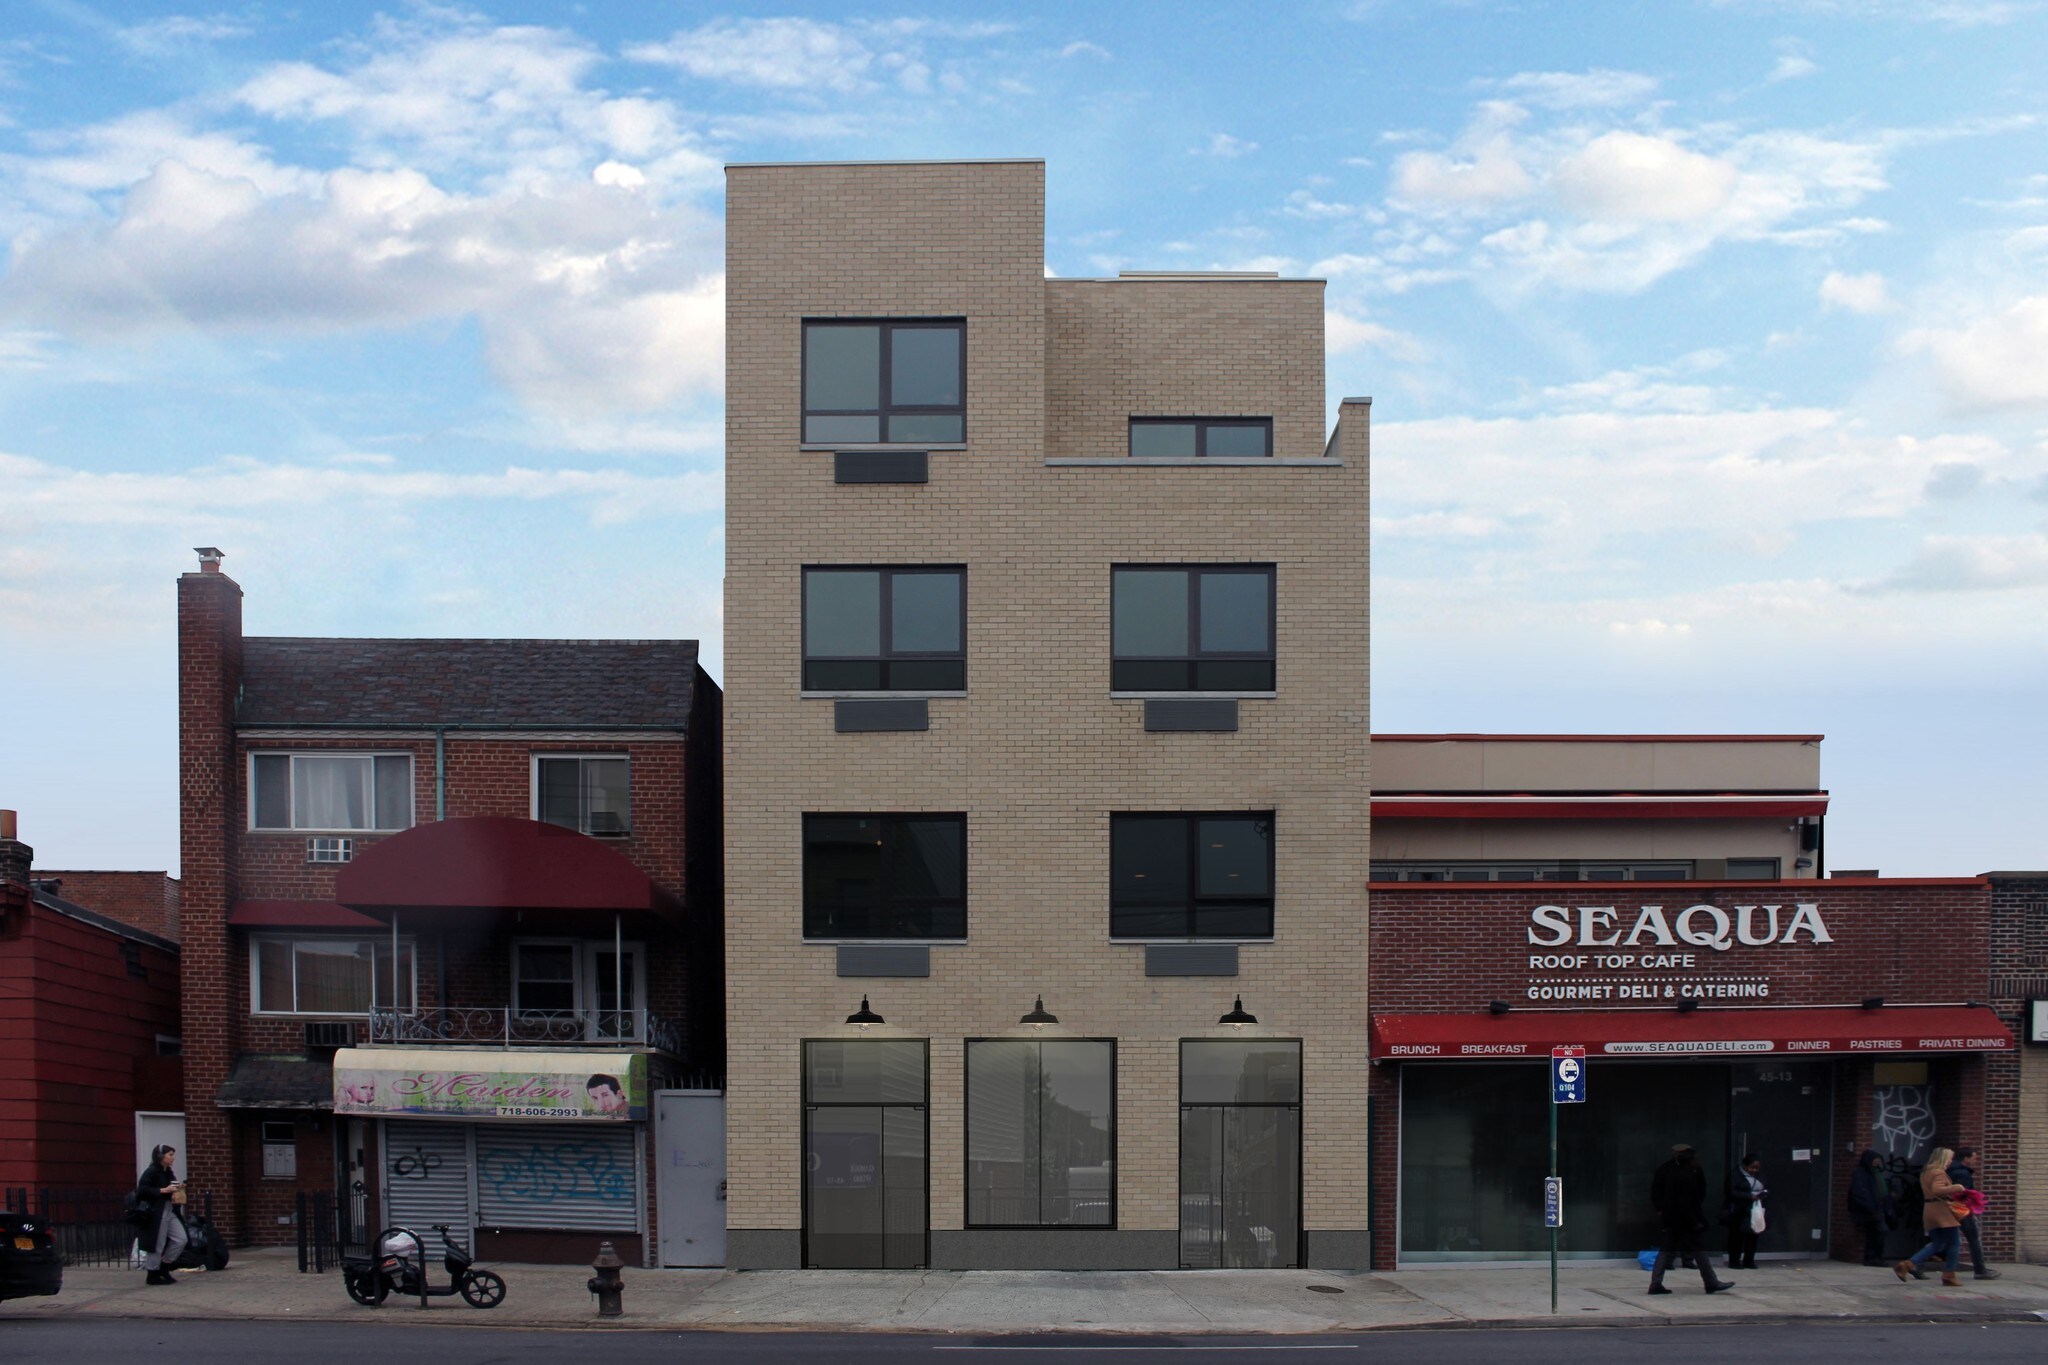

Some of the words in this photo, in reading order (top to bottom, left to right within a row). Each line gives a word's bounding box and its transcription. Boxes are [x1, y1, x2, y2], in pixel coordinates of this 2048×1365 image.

[1528, 903, 1834, 951] SEAQUA
[1529, 955, 1588, 969] ROOF
[1594, 955, 1635, 969] TOP
[1640, 954, 1696, 968] CAFE
[1527, 985, 1614, 1000] GOURMET
[1619, 985, 1658, 999] DELI
[1663, 985, 1675, 998] &
[1681, 984, 1769, 998] CATERING
[1612, 1042, 1767, 1053] www.SEAQUADELI.com
[1787, 1040, 1830, 1050] DINNER
[1850, 1040, 1903, 1049] PASTRIES
[1919, 1039, 1964, 1048] PRIVATE
[1966, 1038, 2006, 1047] DINING
[1391, 1045, 1441, 1055] BRUNCH
[1461, 1044, 1527, 1054] BREAKFAST
[1759, 1072, 1792, 1082] 45-13
[391, 1072, 573, 1100] Maiden
[501, 1107, 578, 1117] 718-606-2993
